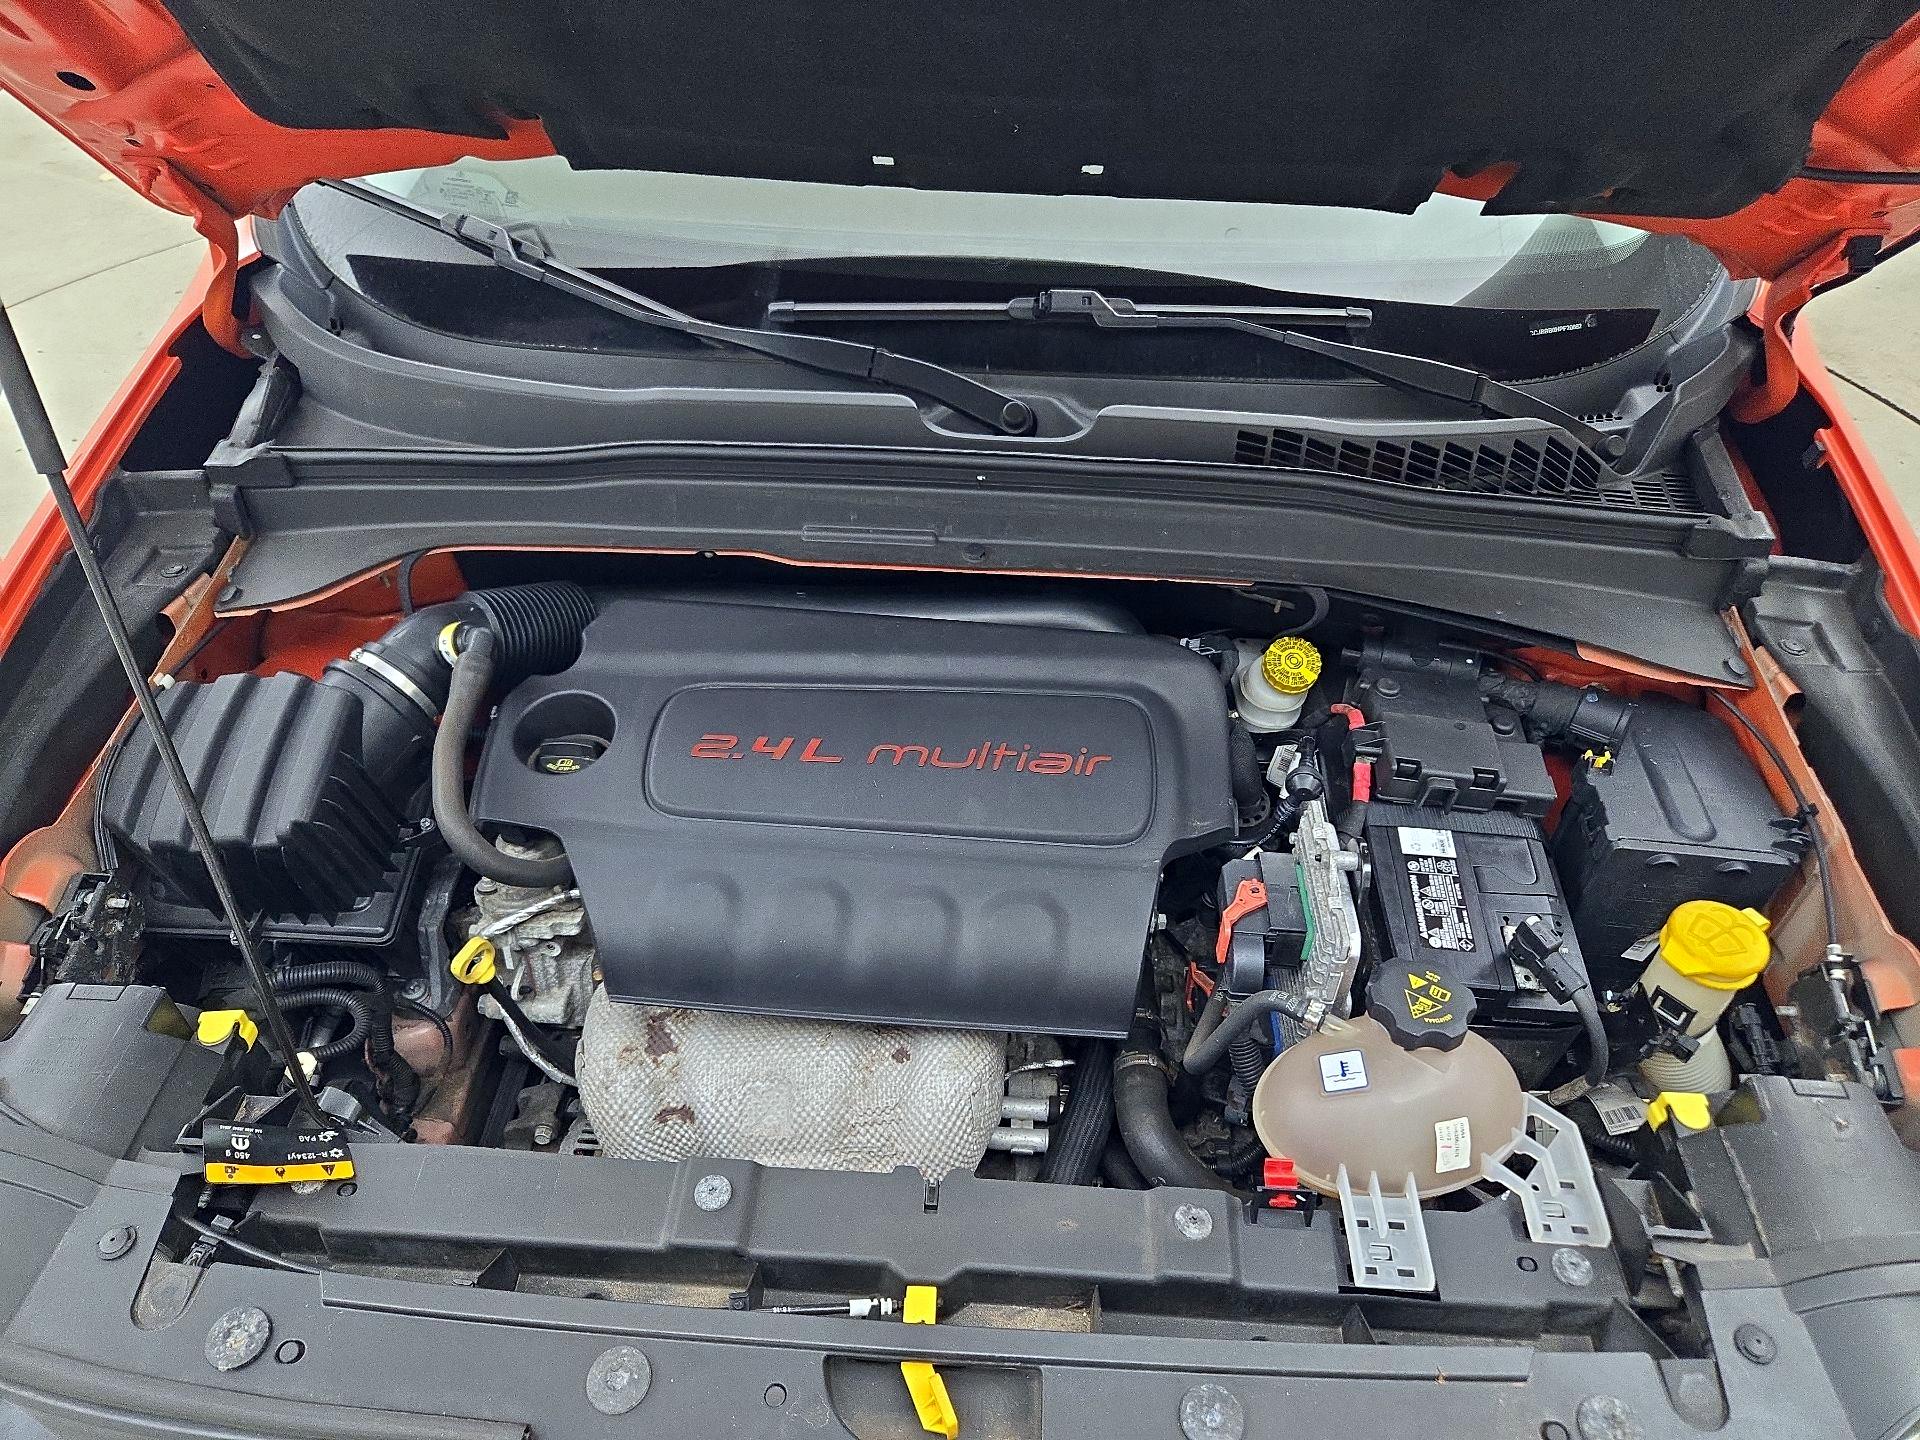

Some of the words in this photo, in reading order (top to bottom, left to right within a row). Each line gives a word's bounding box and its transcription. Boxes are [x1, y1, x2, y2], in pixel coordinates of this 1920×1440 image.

[866, 740, 1113, 777] multiair
[298, 1134, 316, 1143] PAG
[225, 1149, 232, 1157] g
[234, 1151, 251, 1160] 450
